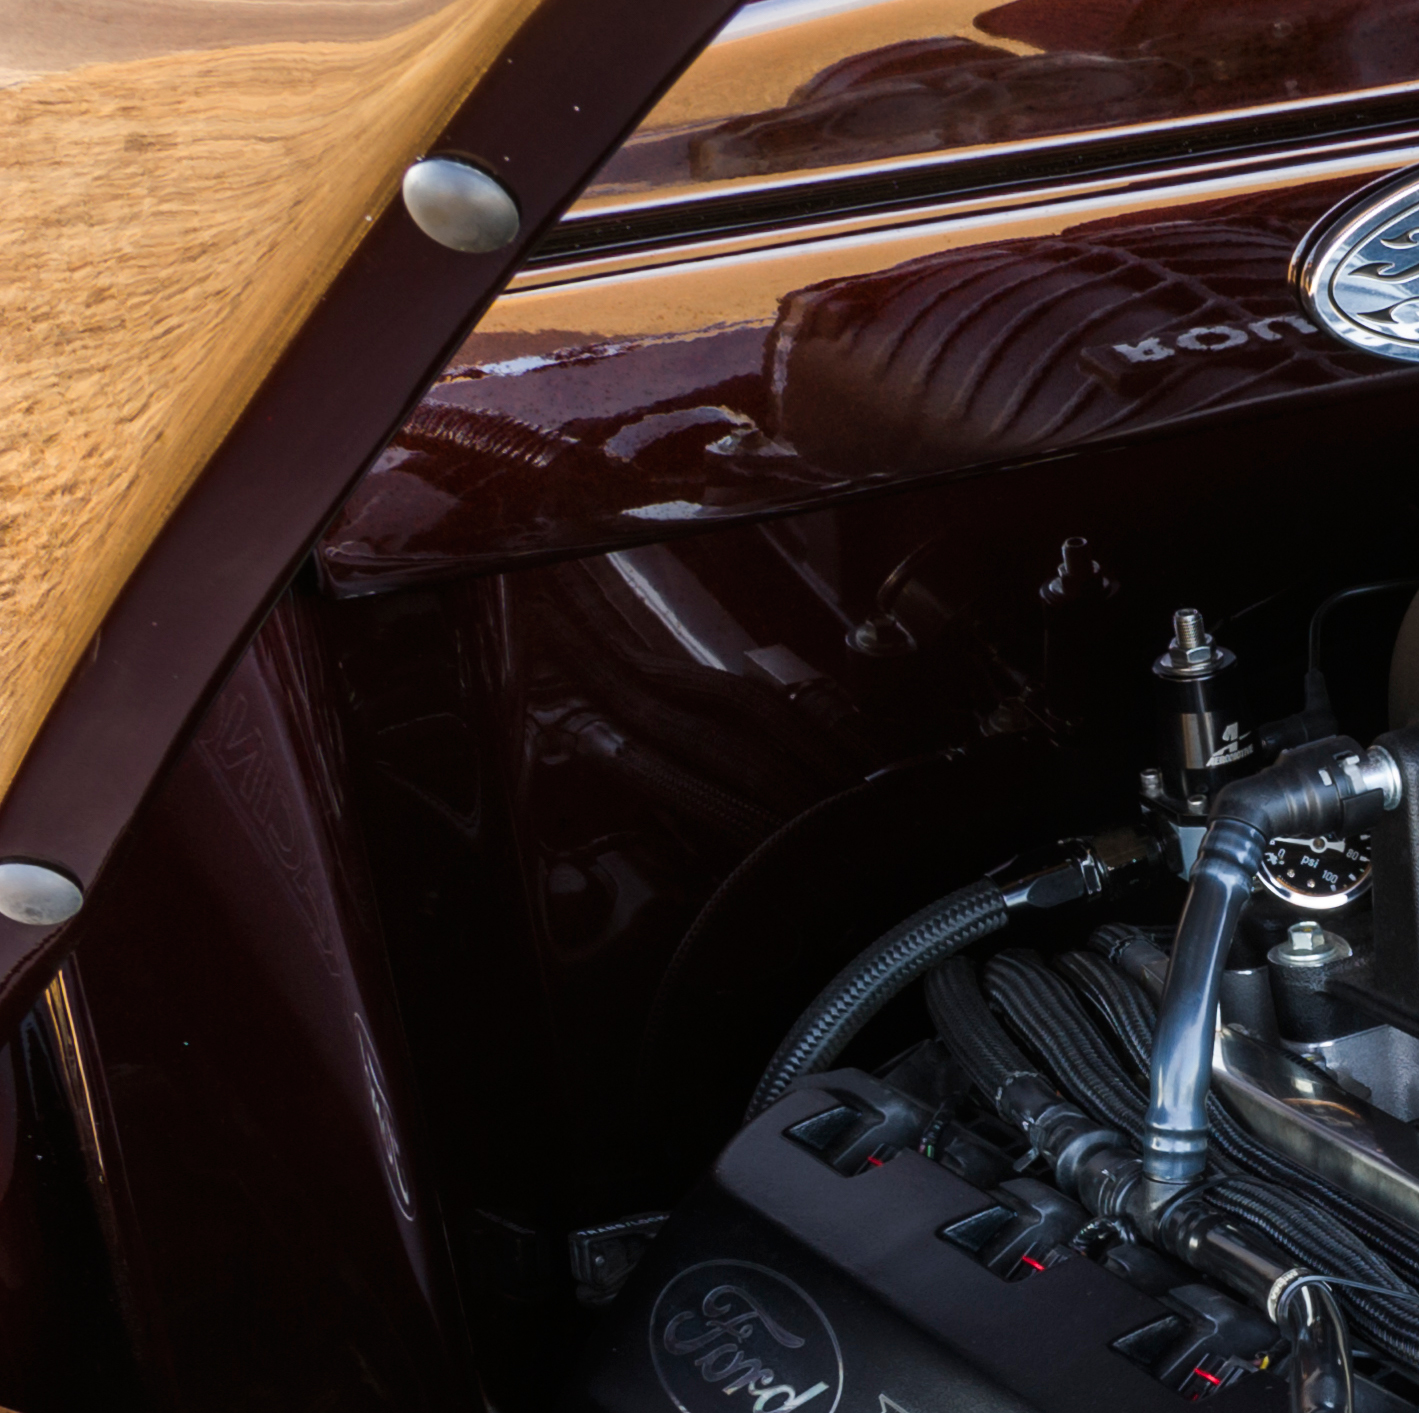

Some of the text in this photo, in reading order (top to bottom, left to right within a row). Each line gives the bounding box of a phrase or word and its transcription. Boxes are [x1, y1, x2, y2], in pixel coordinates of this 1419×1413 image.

[1346, 848, 1359, 860] 80
[1300, 855, 1320, 868] psi
[1321, 869, 1338, 884] 100
